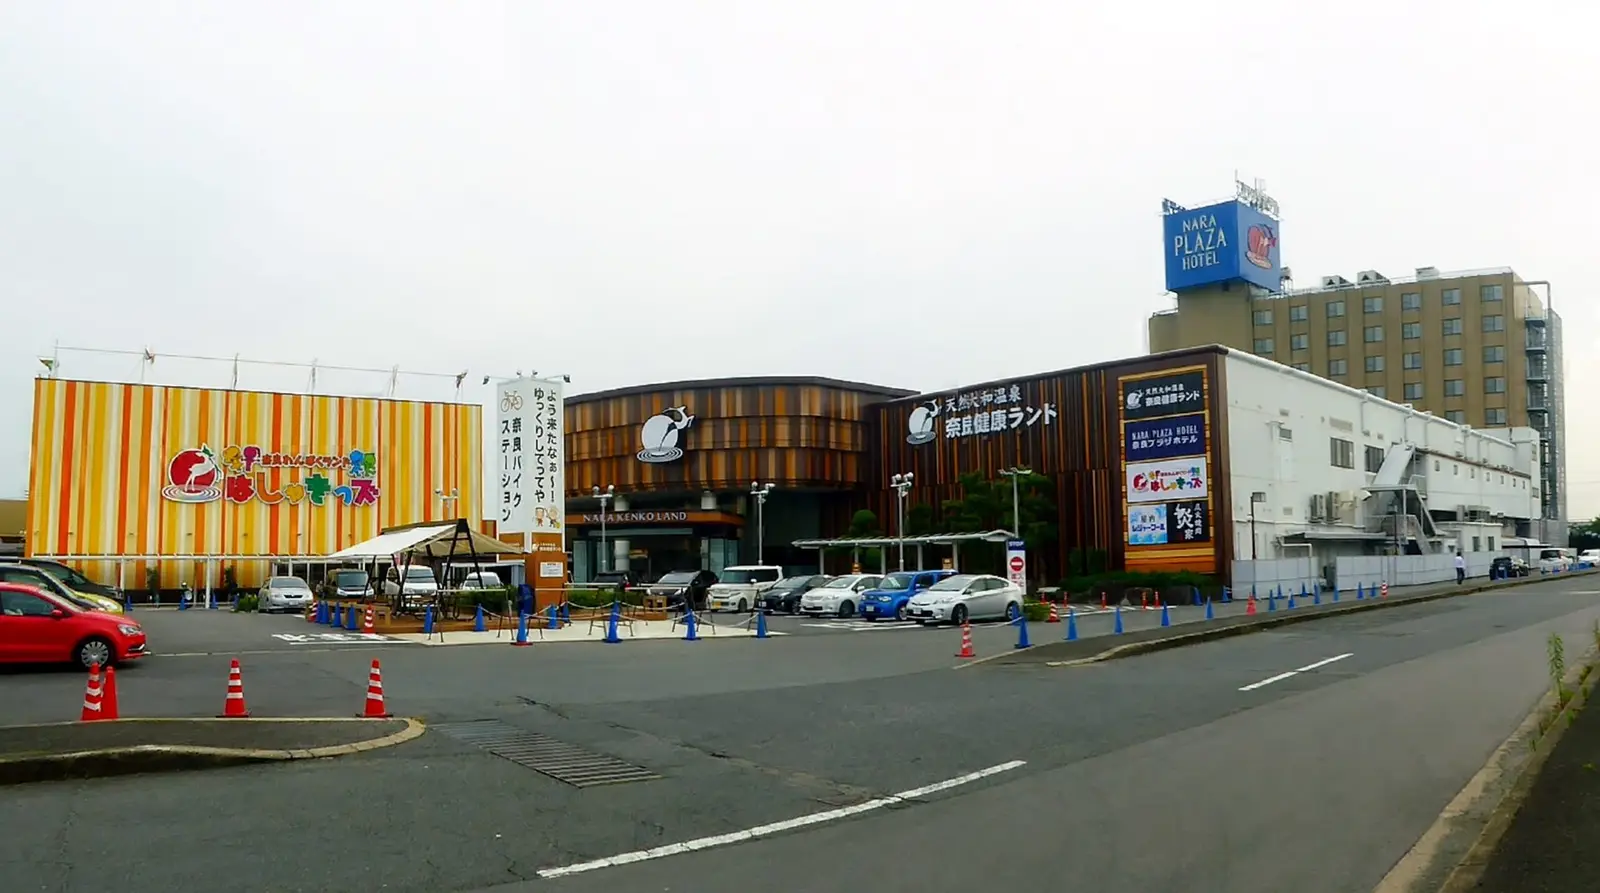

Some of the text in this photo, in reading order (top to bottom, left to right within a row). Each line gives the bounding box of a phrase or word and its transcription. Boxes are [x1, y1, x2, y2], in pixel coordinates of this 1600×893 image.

[1182, 214, 1217, 233] NARA
[1174, 227, 1227, 256] PLAZA
[1182, 251, 1220, 271] HOTEL
[945, 384, 1023, 413] 天然大和温泉
[945, 403, 1058, 439] 奈良健康ランド
[1152, 427, 1173, 438] PLAZA
[1176, 425, 1199, 435] HOTEL
[534, 387, 546, 504] ゆっくりしてってや
[501, 420, 512, 523] ステーション
[512, 417, 522, 508] 奈良バイク
[616, 511, 654, 521] KENKO
[657, 511, 687, 521] LAND
